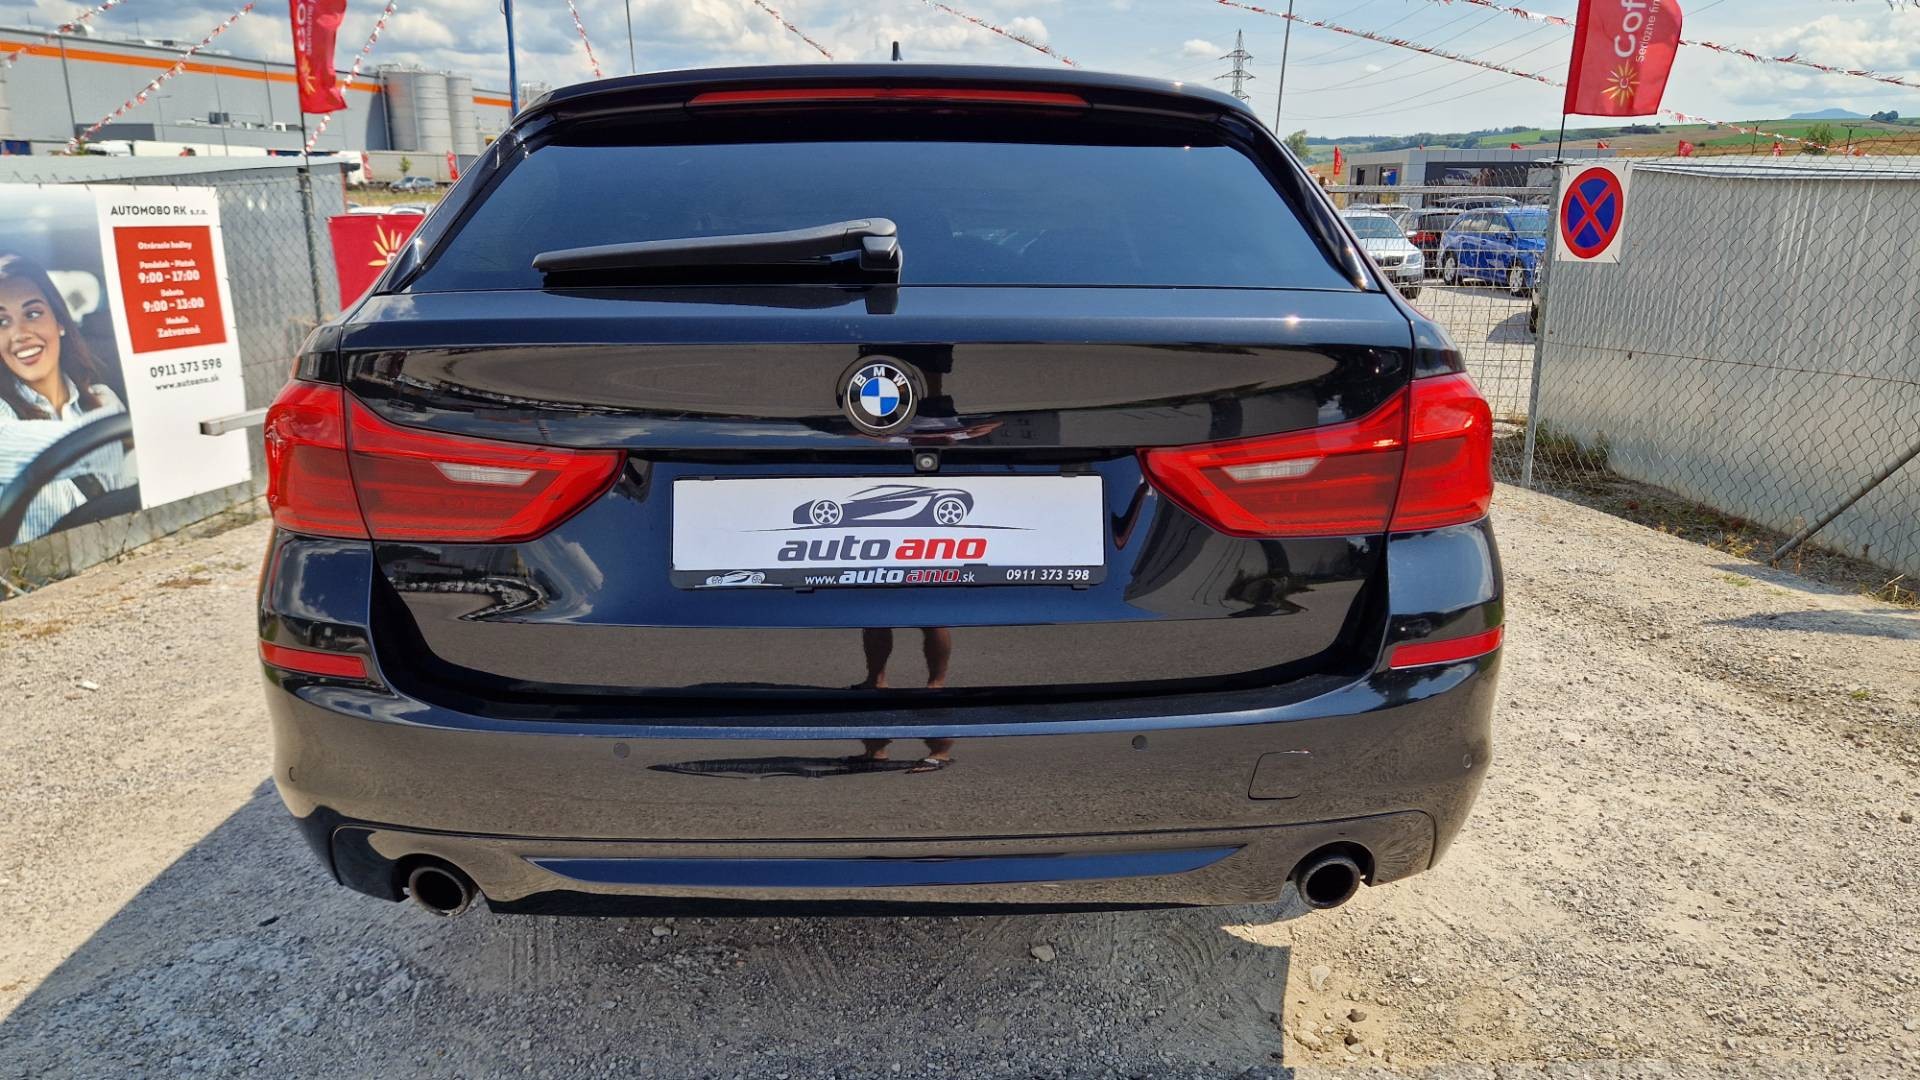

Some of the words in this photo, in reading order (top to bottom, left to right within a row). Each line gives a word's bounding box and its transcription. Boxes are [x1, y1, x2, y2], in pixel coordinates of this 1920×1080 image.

[110, 205, 171, 216] AUTOMOBO
[173, 205, 187, 216] RK
[138, 272, 164, 284] 9:00
[172, 270, 200, 282] 17:00
[142, 300, 168, 313] 9:00
[176, 297, 205, 310] 13:00
[150, 364, 177, 378] 0911
[179, 361, 200, 374] 373
[202, 357, 222, 370] 598
[155, 374, 219, 390] www.autoano.sk
[853, 366, 906, 388] BMW
[1006, 569, 1037, 581] 0911
[1040, 569, 1063, 581] 373
[1066, 569, 1090, 581] 598
